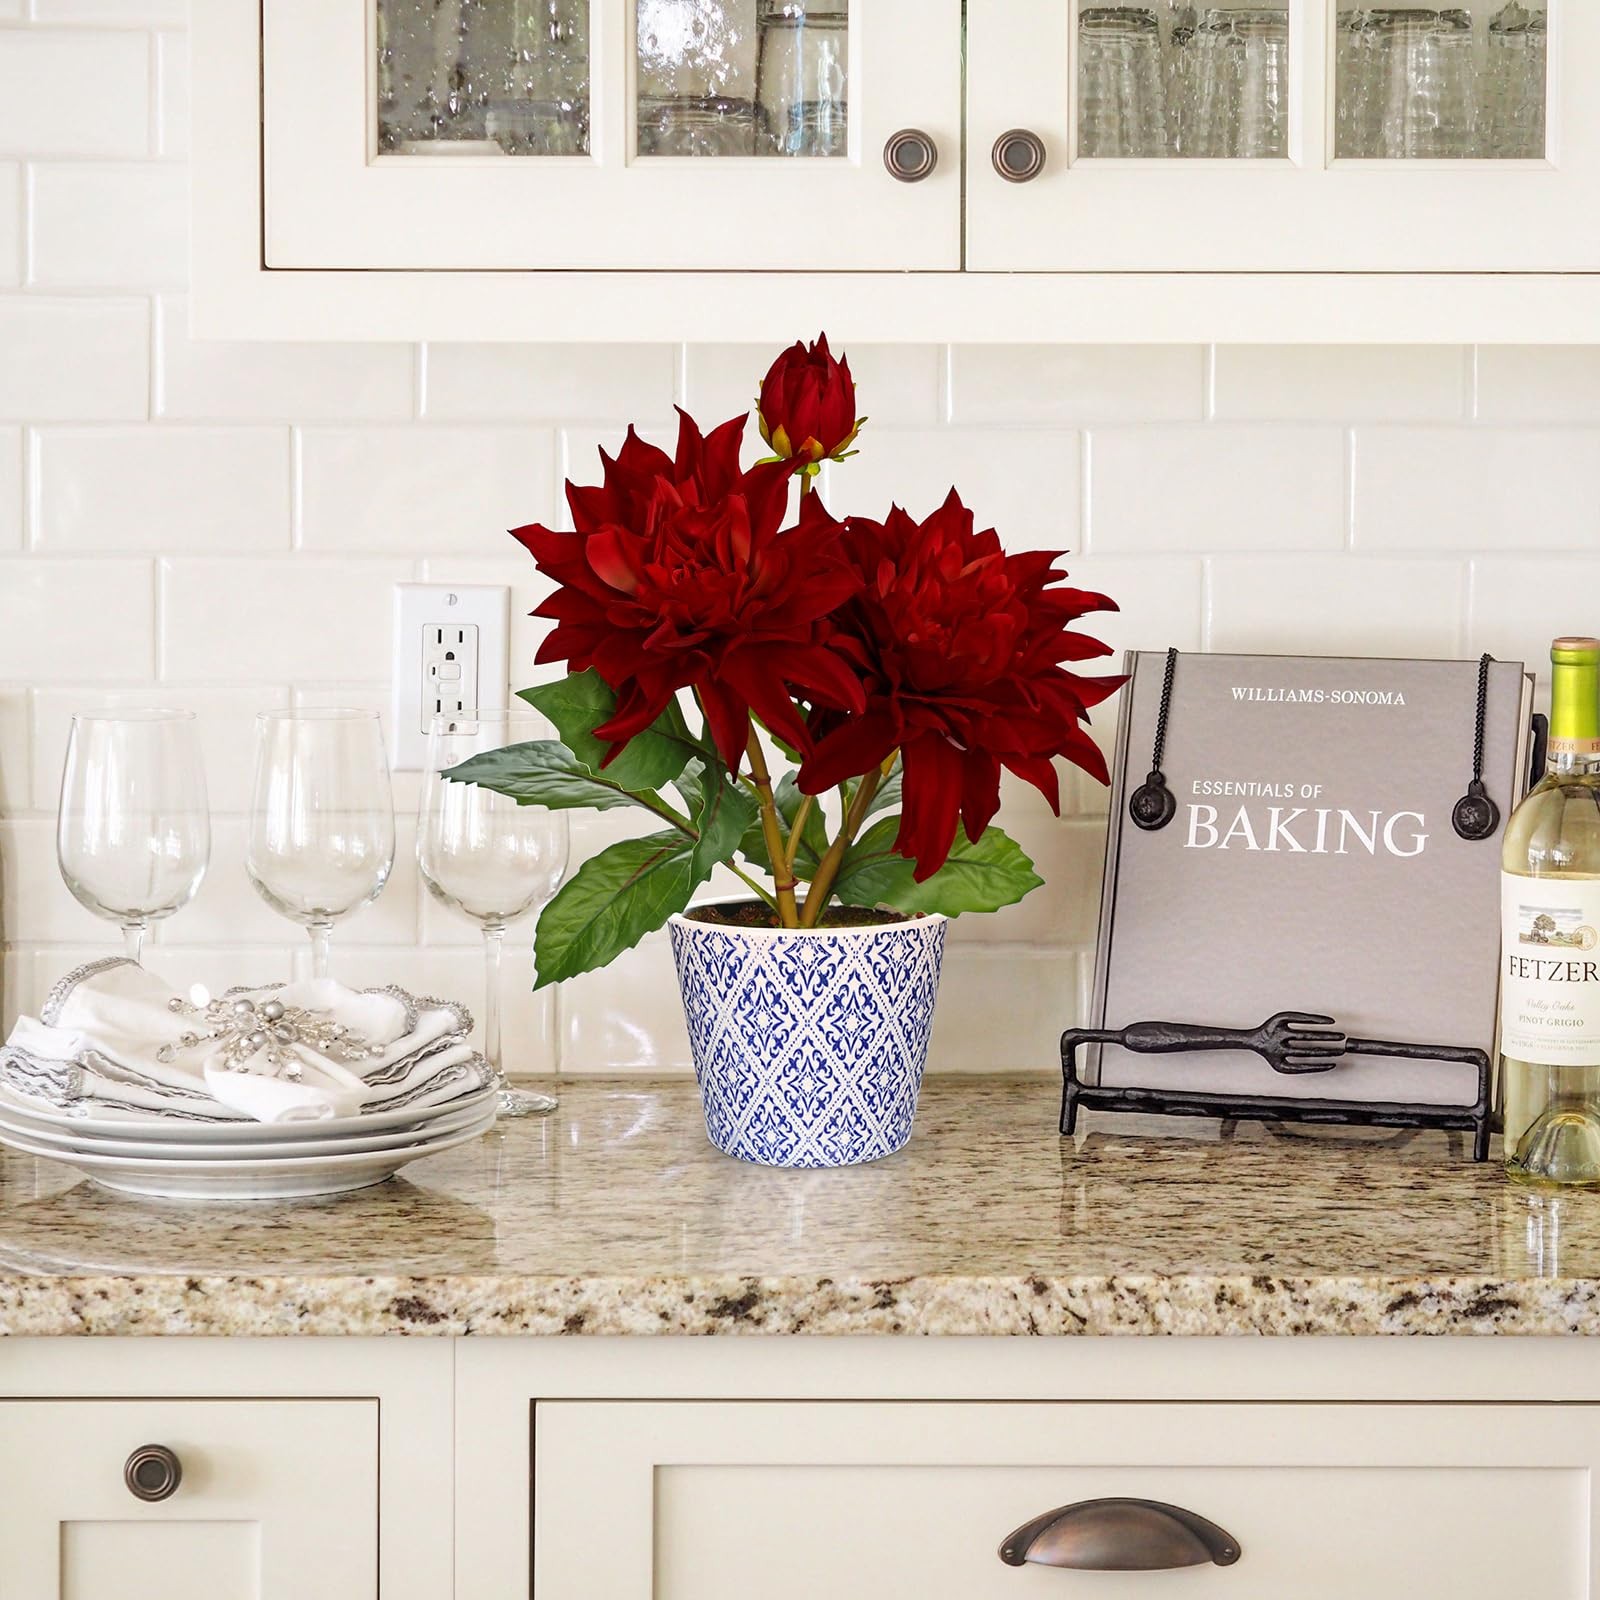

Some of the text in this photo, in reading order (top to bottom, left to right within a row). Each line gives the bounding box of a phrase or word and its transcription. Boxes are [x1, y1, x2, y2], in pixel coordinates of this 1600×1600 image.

[1231, 687, 1406, 706] WILLIAMS-SONOMA
[1192, 780, 1323, 799] ESSENTIALS OF
[1183, 803, 1430, 857] BAKING
[1509, 955, 1600, 983] FETZER
[1519, 1015, 1584, 1027] PINOT GRIGIO
